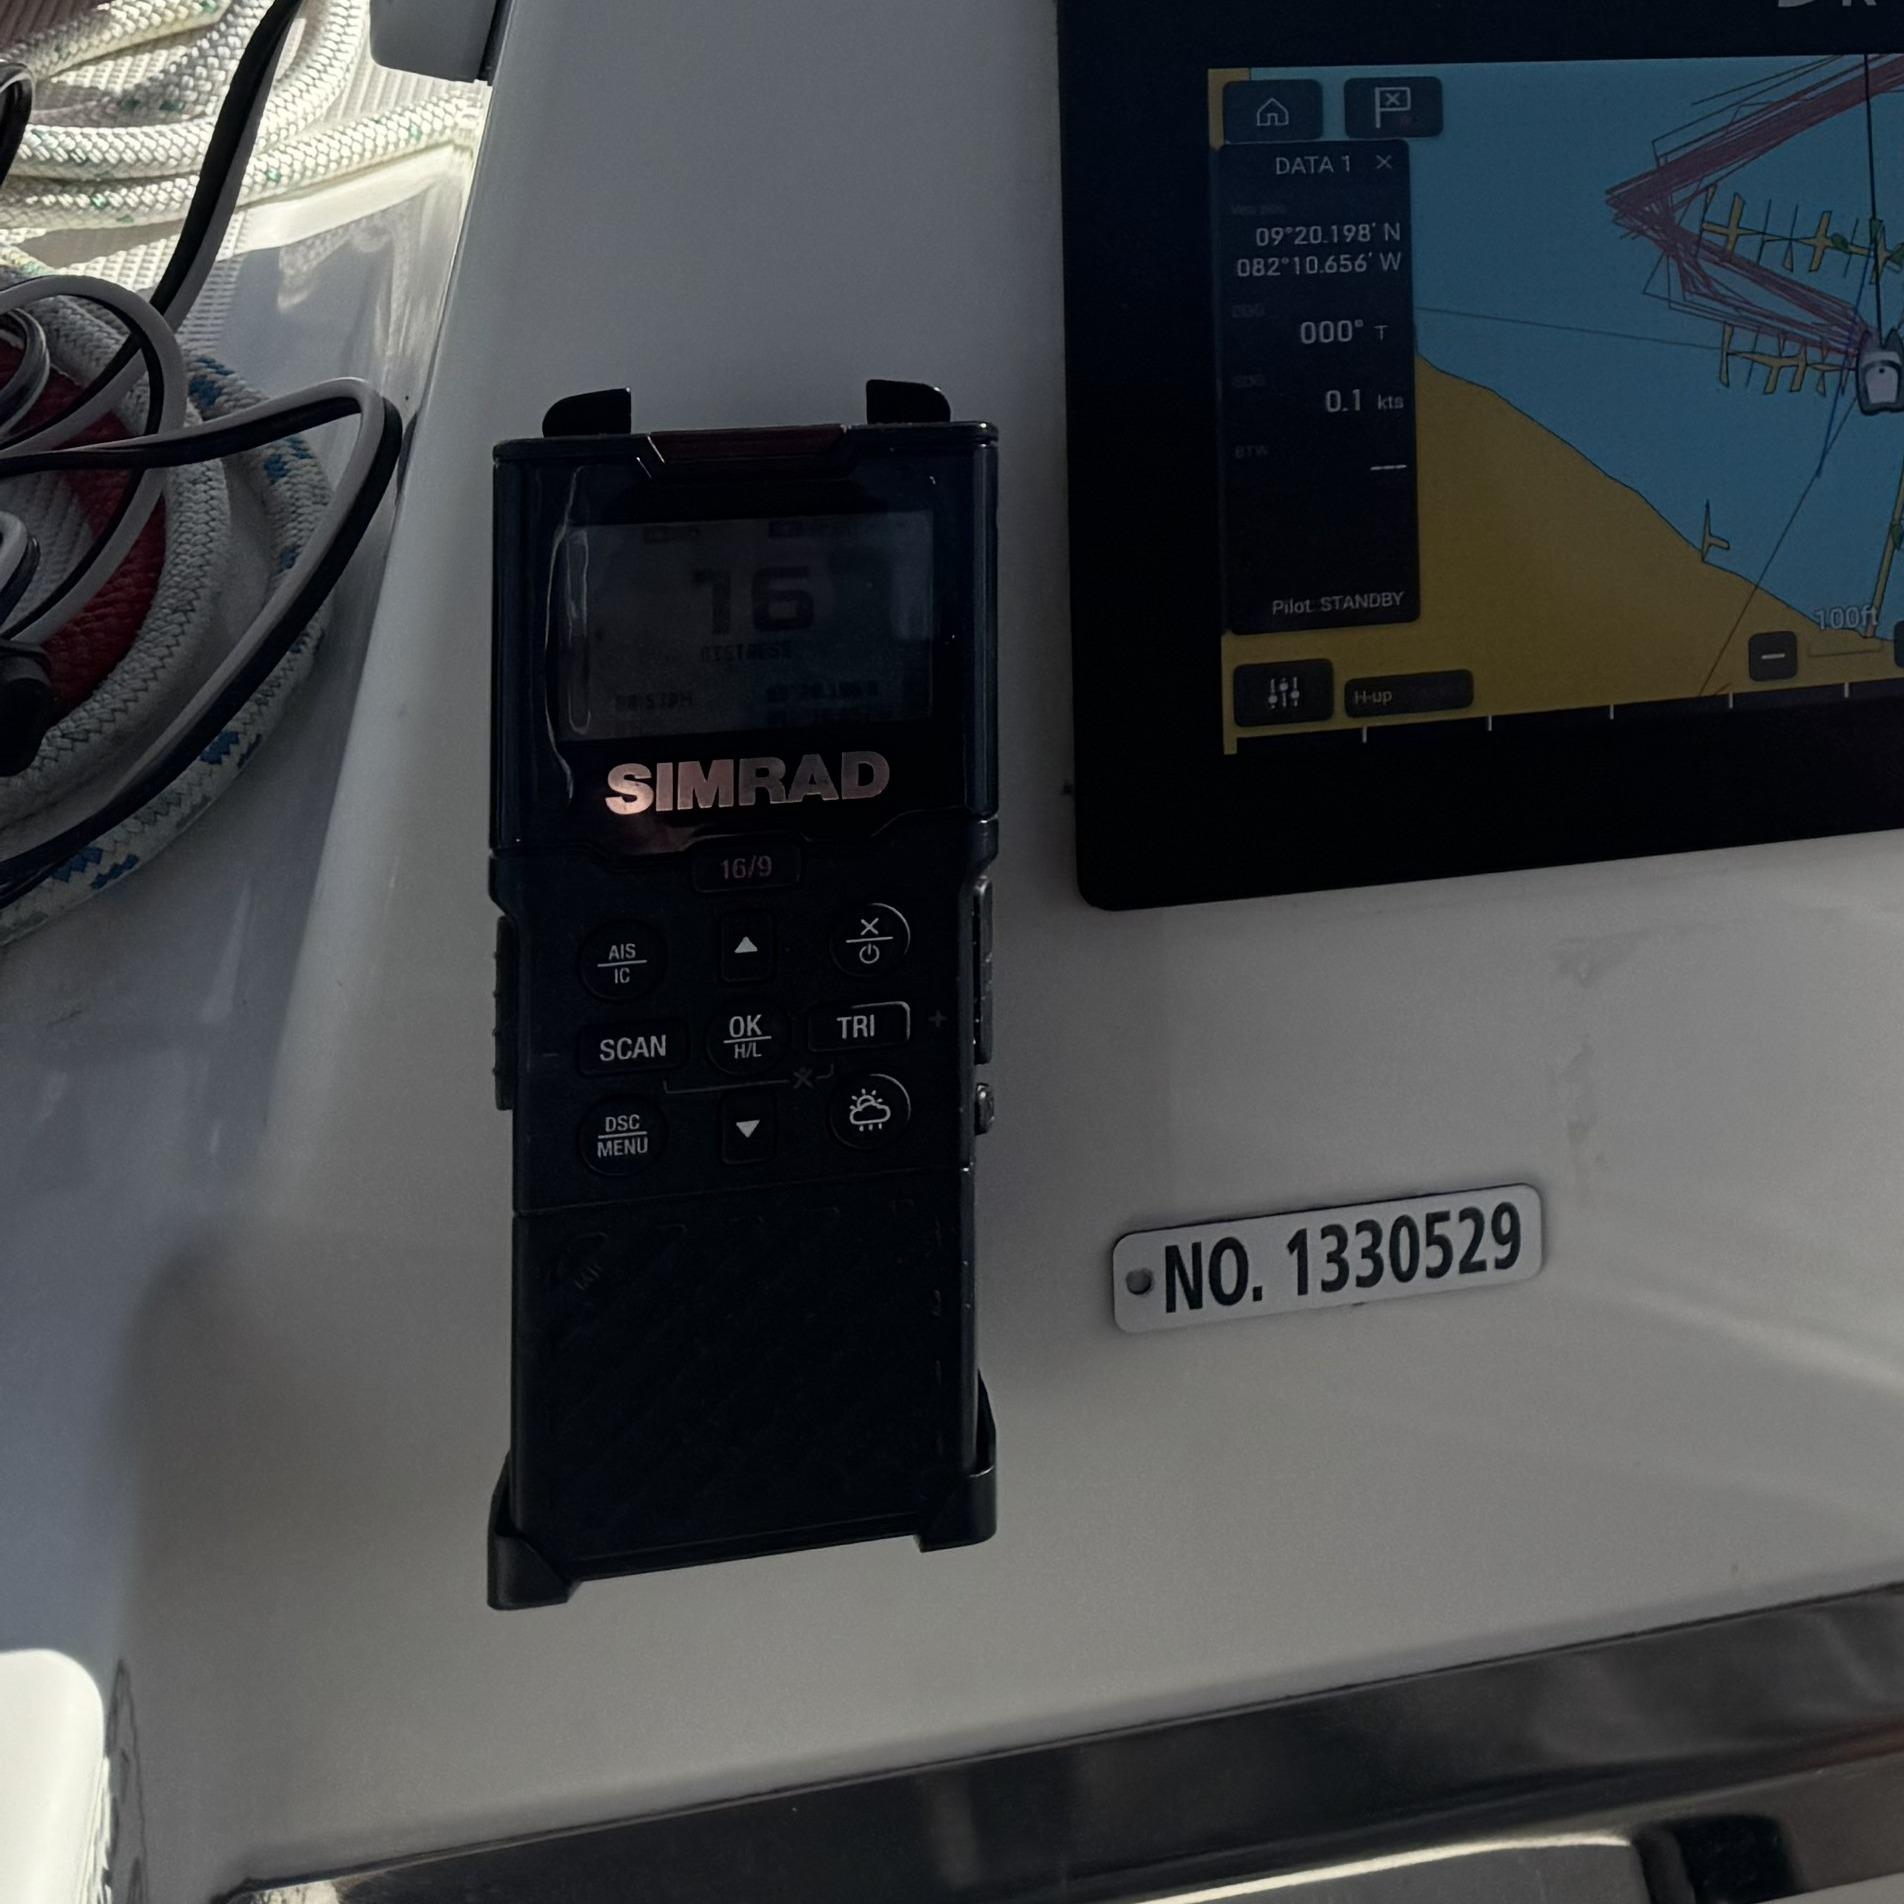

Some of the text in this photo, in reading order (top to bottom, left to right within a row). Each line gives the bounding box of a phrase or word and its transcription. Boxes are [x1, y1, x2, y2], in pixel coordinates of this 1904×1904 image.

[1275, 155, 1351, 175] DATA 1
[1383, 223, 1401, 241] N
[1380, 252, 1402, 271] W
[1300, 318, 1389, 344] 000° T
[1325, 388, 1405, 412] 0.1 kts
[1320, 591, 1405, 612] STANDBY
[1815, 604, 1879, 630] 100ft
[605, 751, 890, 816] SIMRAD
[720, 856, 773, 880] 16/9
[608, 942, 637, 961] AIS
[613, 967, 631, 984] IC
[728, 1014, 763, 1038] OK
[836, 1014, 876, 1040] TRI
[599, 1034, 667, 1062] SCAN
[733, 1043, 762, 1059] H/L
[604, 1114, 641, 1132] DSC
[597, 1137, 649, 1158] MENU
[1164, 1201, 1522, 1314] NO. 1330529
